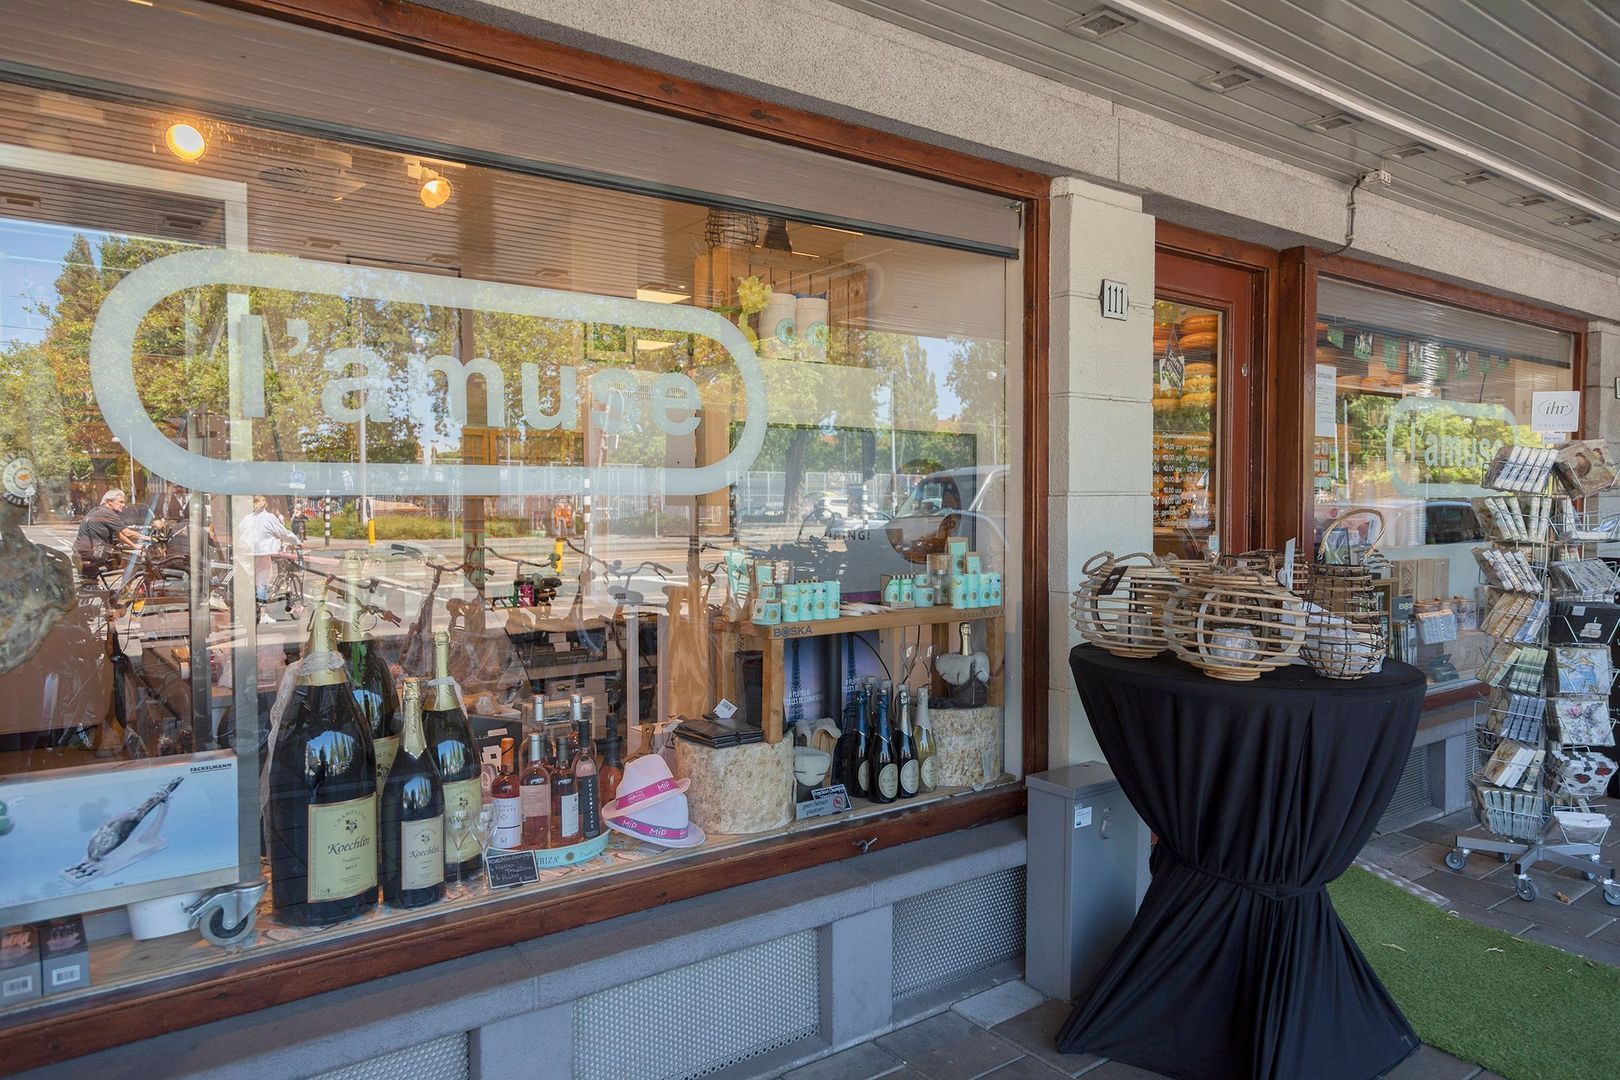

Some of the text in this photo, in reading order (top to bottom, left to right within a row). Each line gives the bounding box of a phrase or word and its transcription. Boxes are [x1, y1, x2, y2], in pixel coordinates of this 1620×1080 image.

[1107, 284, 1124, 314] 111
[240, 313, 702, 436] l'amuse
[1546, 401, 1568, 415] ihr
[773, 625, 813, 638] BOSKA
[190, 762, 232, 772] FACKELMANN
[327, 834, 370, 855] Koechlin
